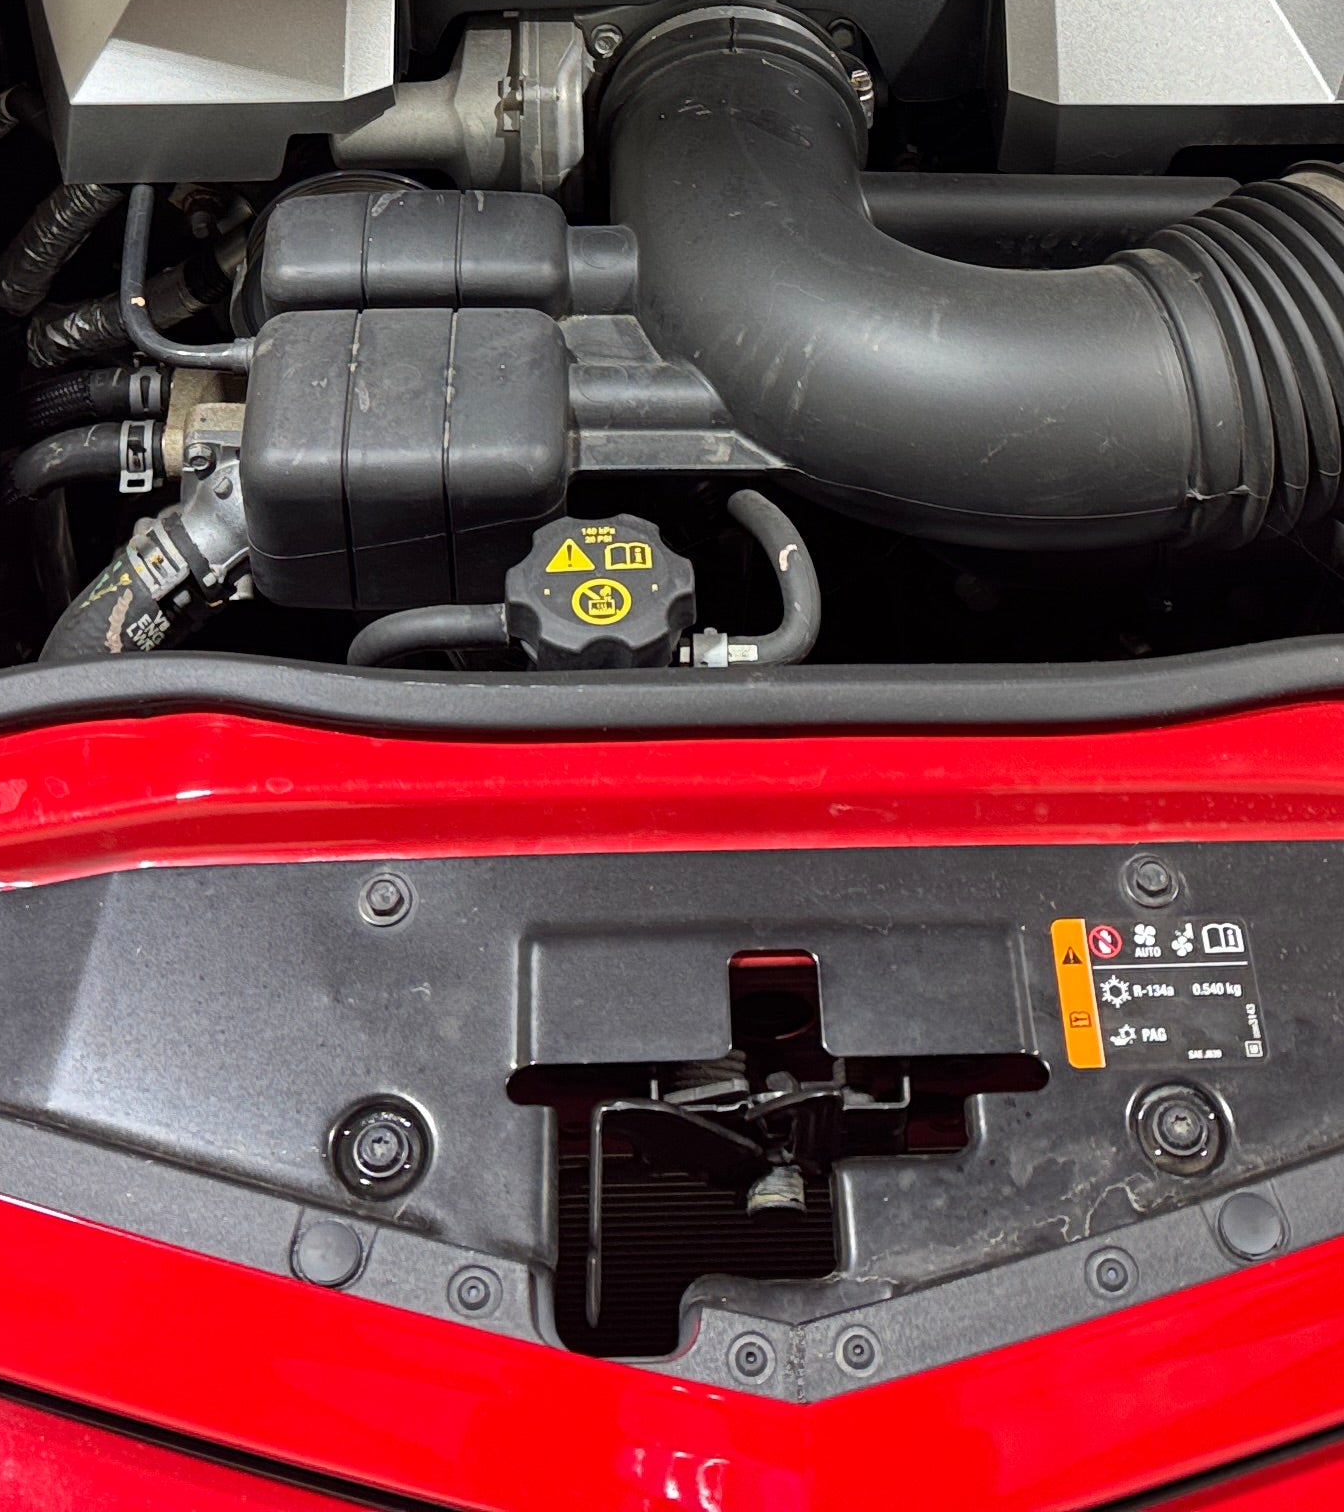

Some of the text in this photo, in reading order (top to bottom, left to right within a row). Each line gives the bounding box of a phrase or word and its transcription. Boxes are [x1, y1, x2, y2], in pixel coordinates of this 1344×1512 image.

[126, 622, 156, 652] LWR
[137, 613, 166, 645] ENG
[1134, 946, 1162, 958] AUTO
[1132, 981, 1243, 998] R-134a 0.540 kg
[1141, 1027, 1168, 1042] PAG
